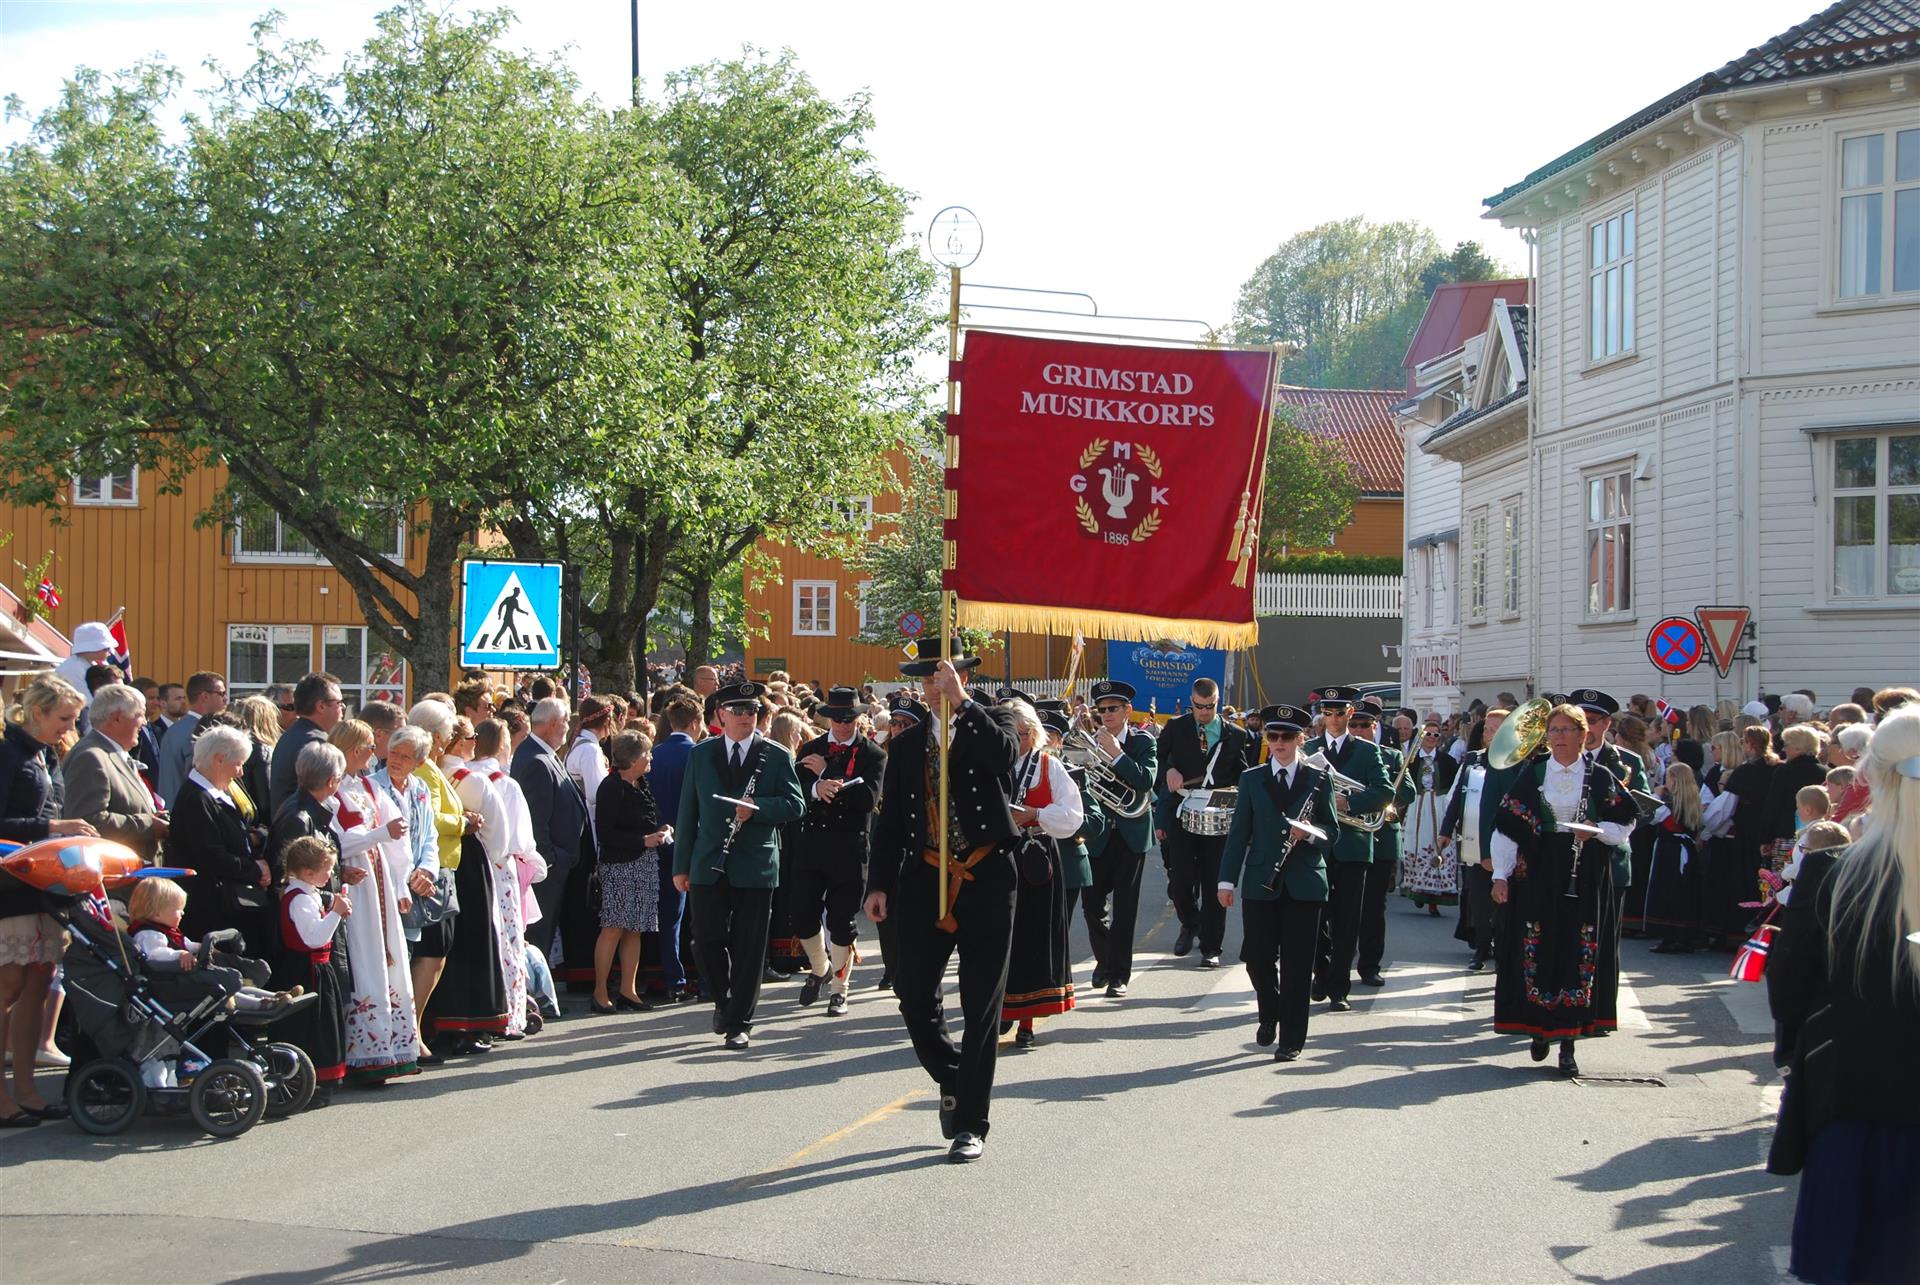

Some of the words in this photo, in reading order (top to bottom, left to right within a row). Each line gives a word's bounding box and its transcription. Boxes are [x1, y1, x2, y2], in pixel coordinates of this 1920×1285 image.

[1042, 363, 1193, 395] GRIMSTAD
[1020, 391, 1215, 427] MUSIKKORPS
[1113, 441, 1131, 460] M
[1069, 474, 1088, 493] G
[1151, 486, 1170, 506] K
[1103, 531, 1130, 546] 1886
[1139, 658, 1194, 671] GRIMSTAD
[1412, 655, 1439, 688] LOKALER
